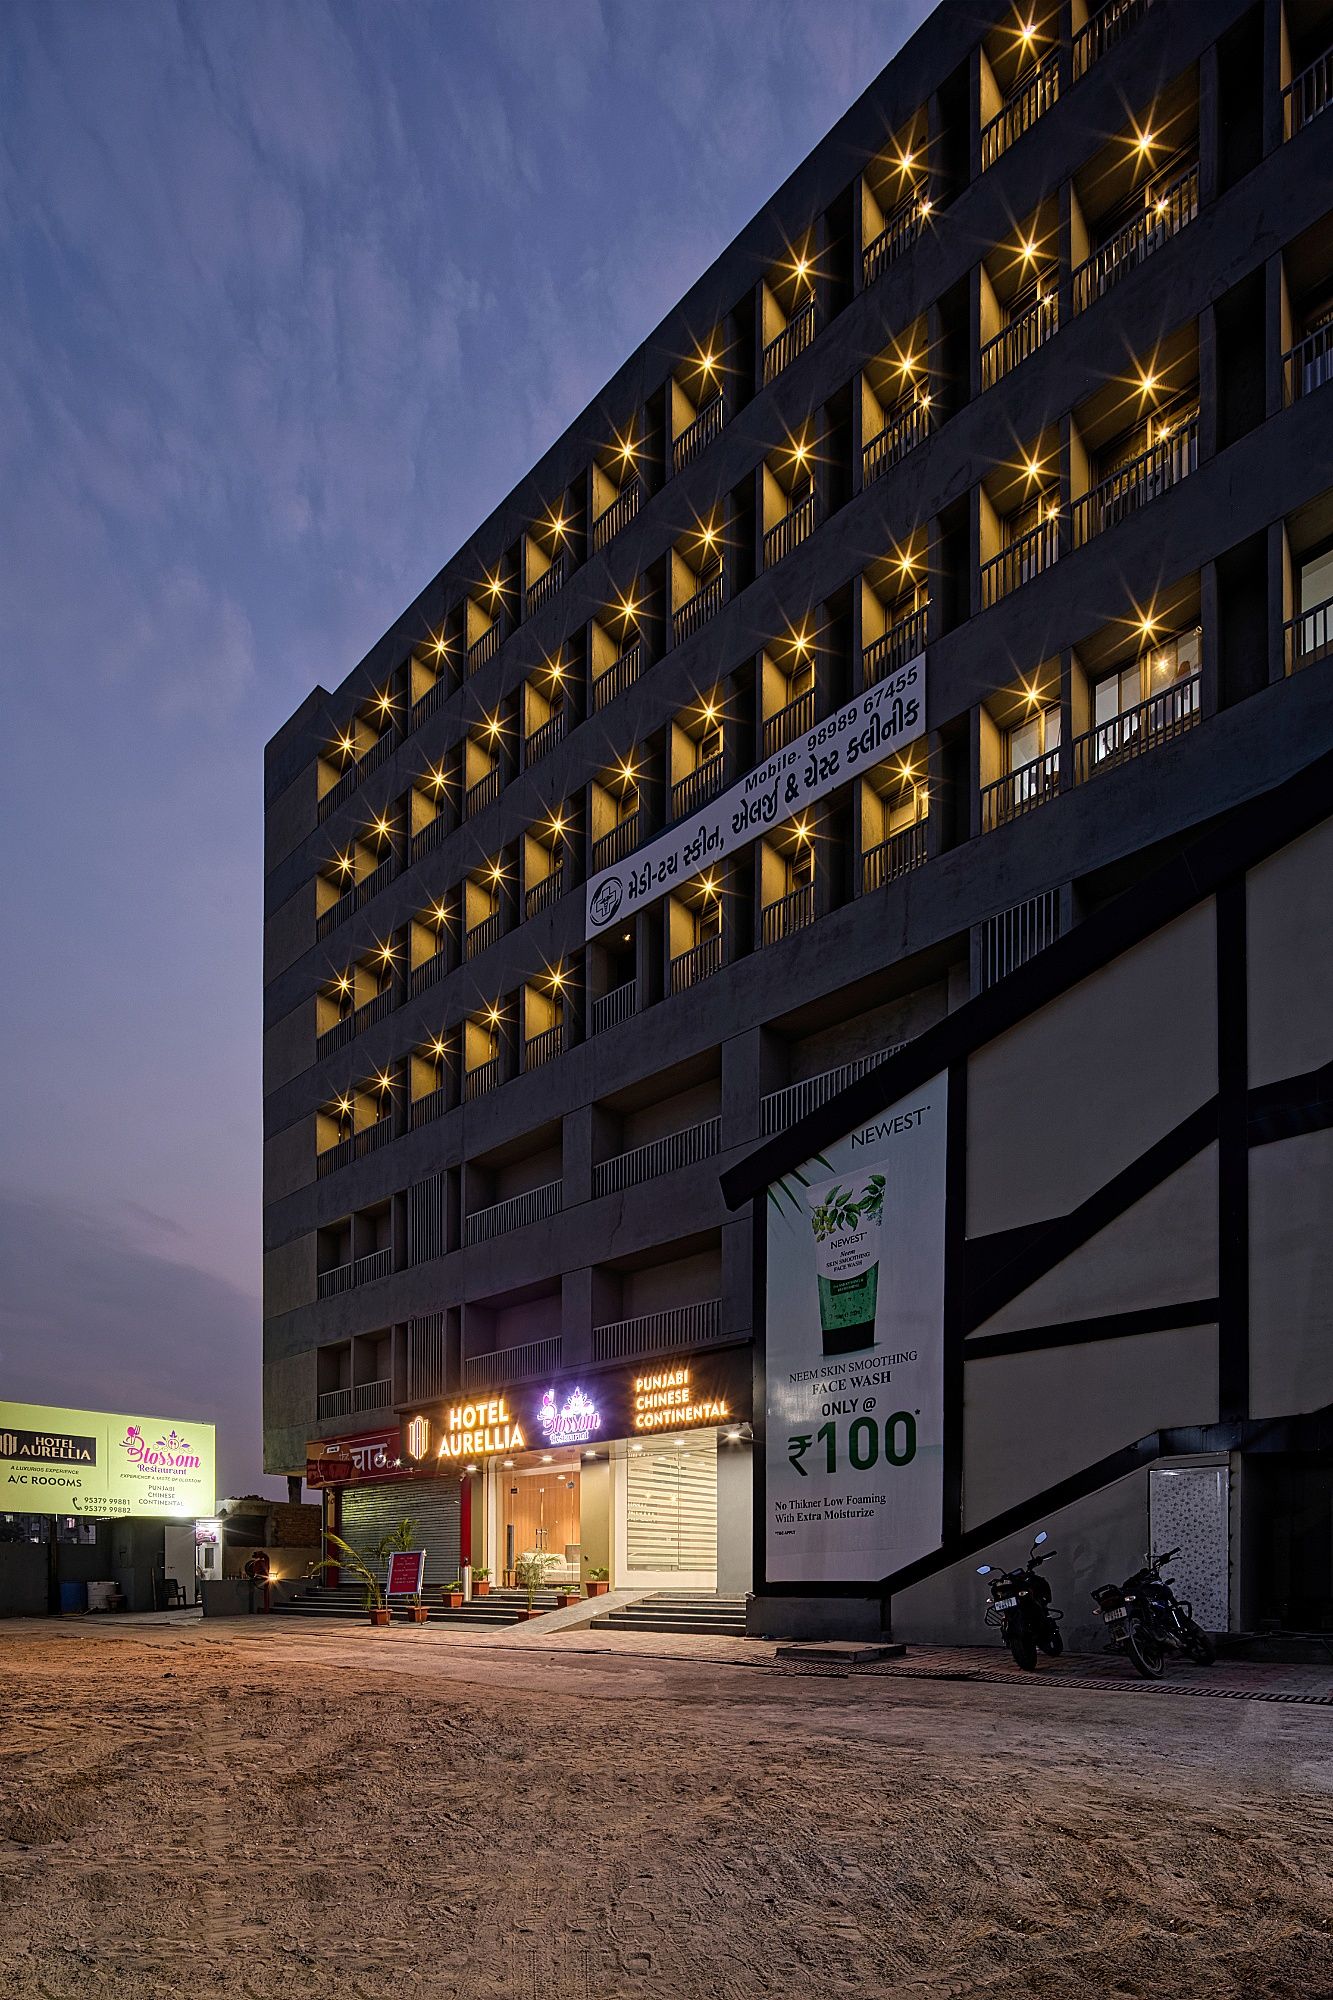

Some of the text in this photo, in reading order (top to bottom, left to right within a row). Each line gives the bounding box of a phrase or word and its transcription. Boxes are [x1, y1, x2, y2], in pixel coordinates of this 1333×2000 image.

[744, 666, 918, 794] Mobile. 98989 67455
[784, 772, 800, 803] &
[851, 1106, 929, 1149] NEWEST
[830, 1232, 867, 1249] NEWEST
[789, 1350, 918, 1383] NEEM SKIN SMOOTHING
[636, 1368, 689, 1393] PUNJABI
[811, 1370, 892, 1396] FACE WASH
[636, 1388, 690, 1411] CHINESE
[821, 1397, 877, 1416] ONLY @
[449, 1398, 509, 1431] HOTEL
[635, 1400, 728, 1428] CONTINENTAL
[35, 1436, 76, 1449] HOTEL
[438, 1421, 525, 1458] AURELLIA
[20, 1444, 91, 1461] AURELLIA
[124, 1436, 202, 1469] Blossom
[137, 1464, 187, 1475] Restaurant
[8, 1475, 82, 1488] A/C ROOOMS
[148, 1484, 175, 1492] PUNJABI
[84, 1496, 107, 1504] 95379
[138, 1498, 184, 1507] CONTINENTAL
[147, 1491, 175, 1499] CHINESE
[775, 1492, 886, 1510] No Thikner Low Foaming
[775, 1507, 875, 1523] With Extra Moisturize
